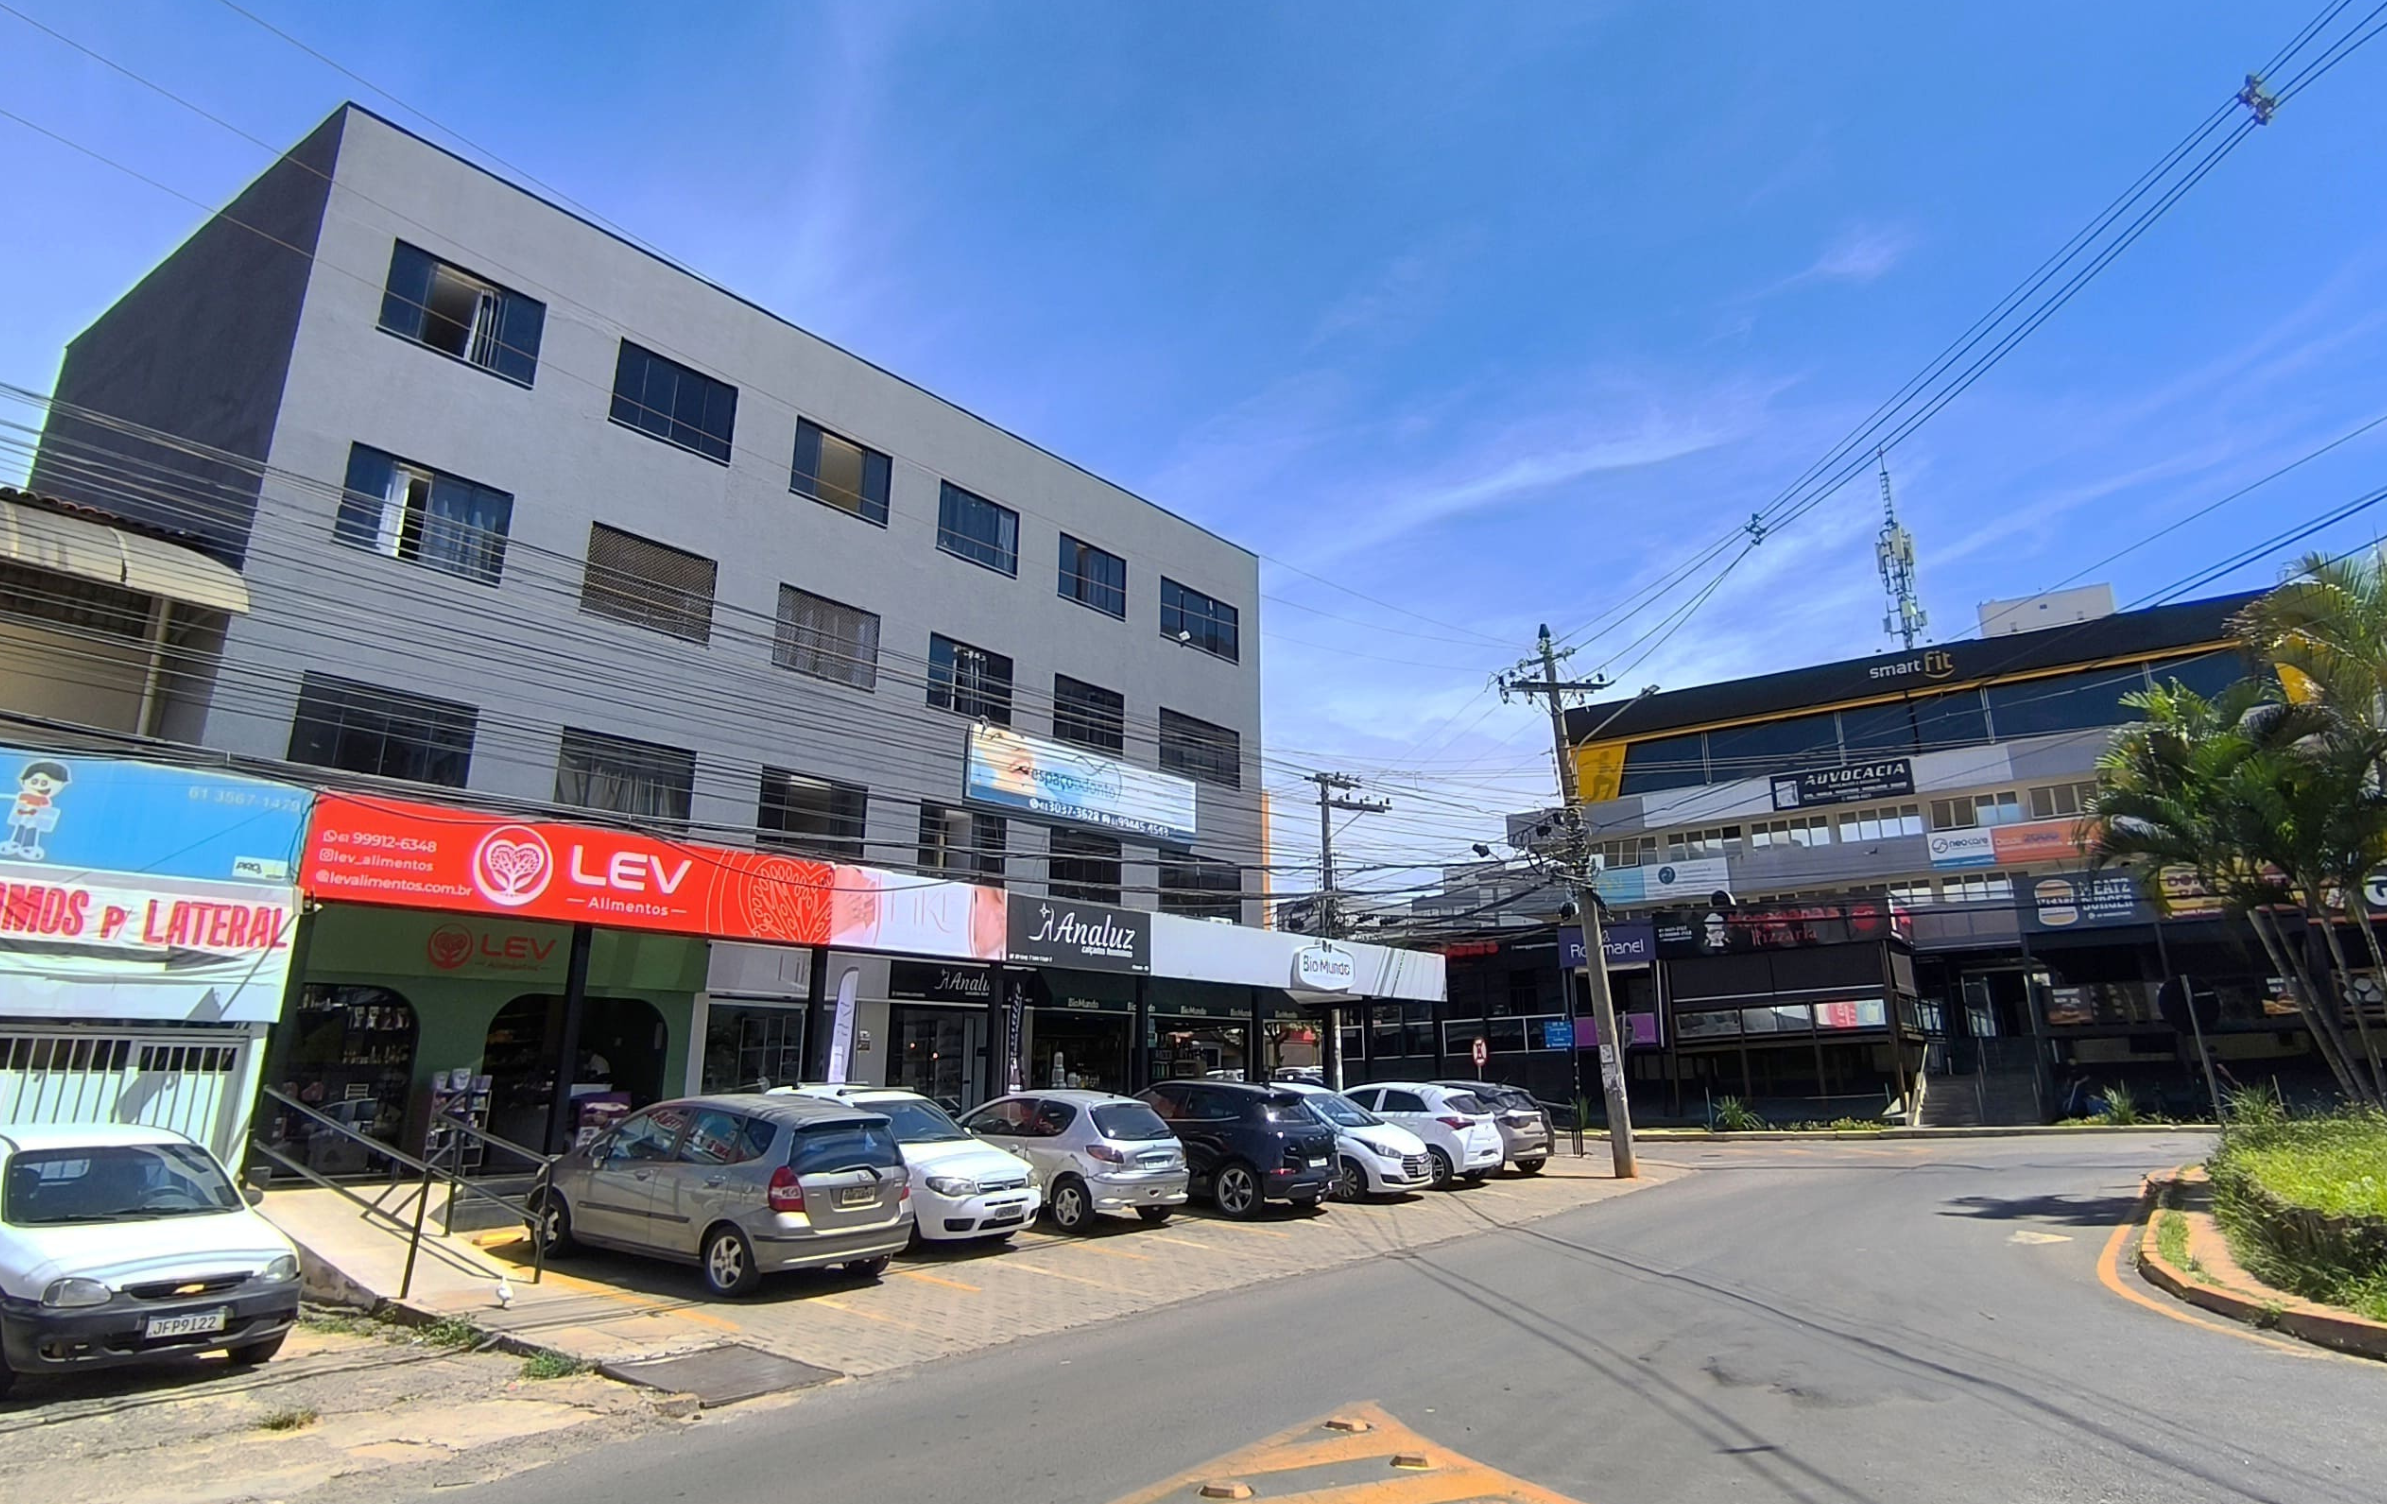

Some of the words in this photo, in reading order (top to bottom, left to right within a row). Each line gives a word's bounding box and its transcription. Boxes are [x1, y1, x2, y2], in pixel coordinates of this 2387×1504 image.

[1869, 660, 1921, 679] smart
[1924, 651, 1953, 673] fit
[352, 832, 437, 853] 99912-6348
[334, 851, 434, 872] lev_alimentos
[571, 845, 692, 894] LEV
[330, 871, 473, 896] levalimentos.com.br
[588, 897, 669, 916] Alimentos
[143, 899, 287, 948] LATERAL
[1053, 912, 1136, 950] Analuz
[481, 933, 557, 960] LEV
[1570, 938, 1644, 959] Romanel
[153, 1316, 217, 1335] JFP9122
